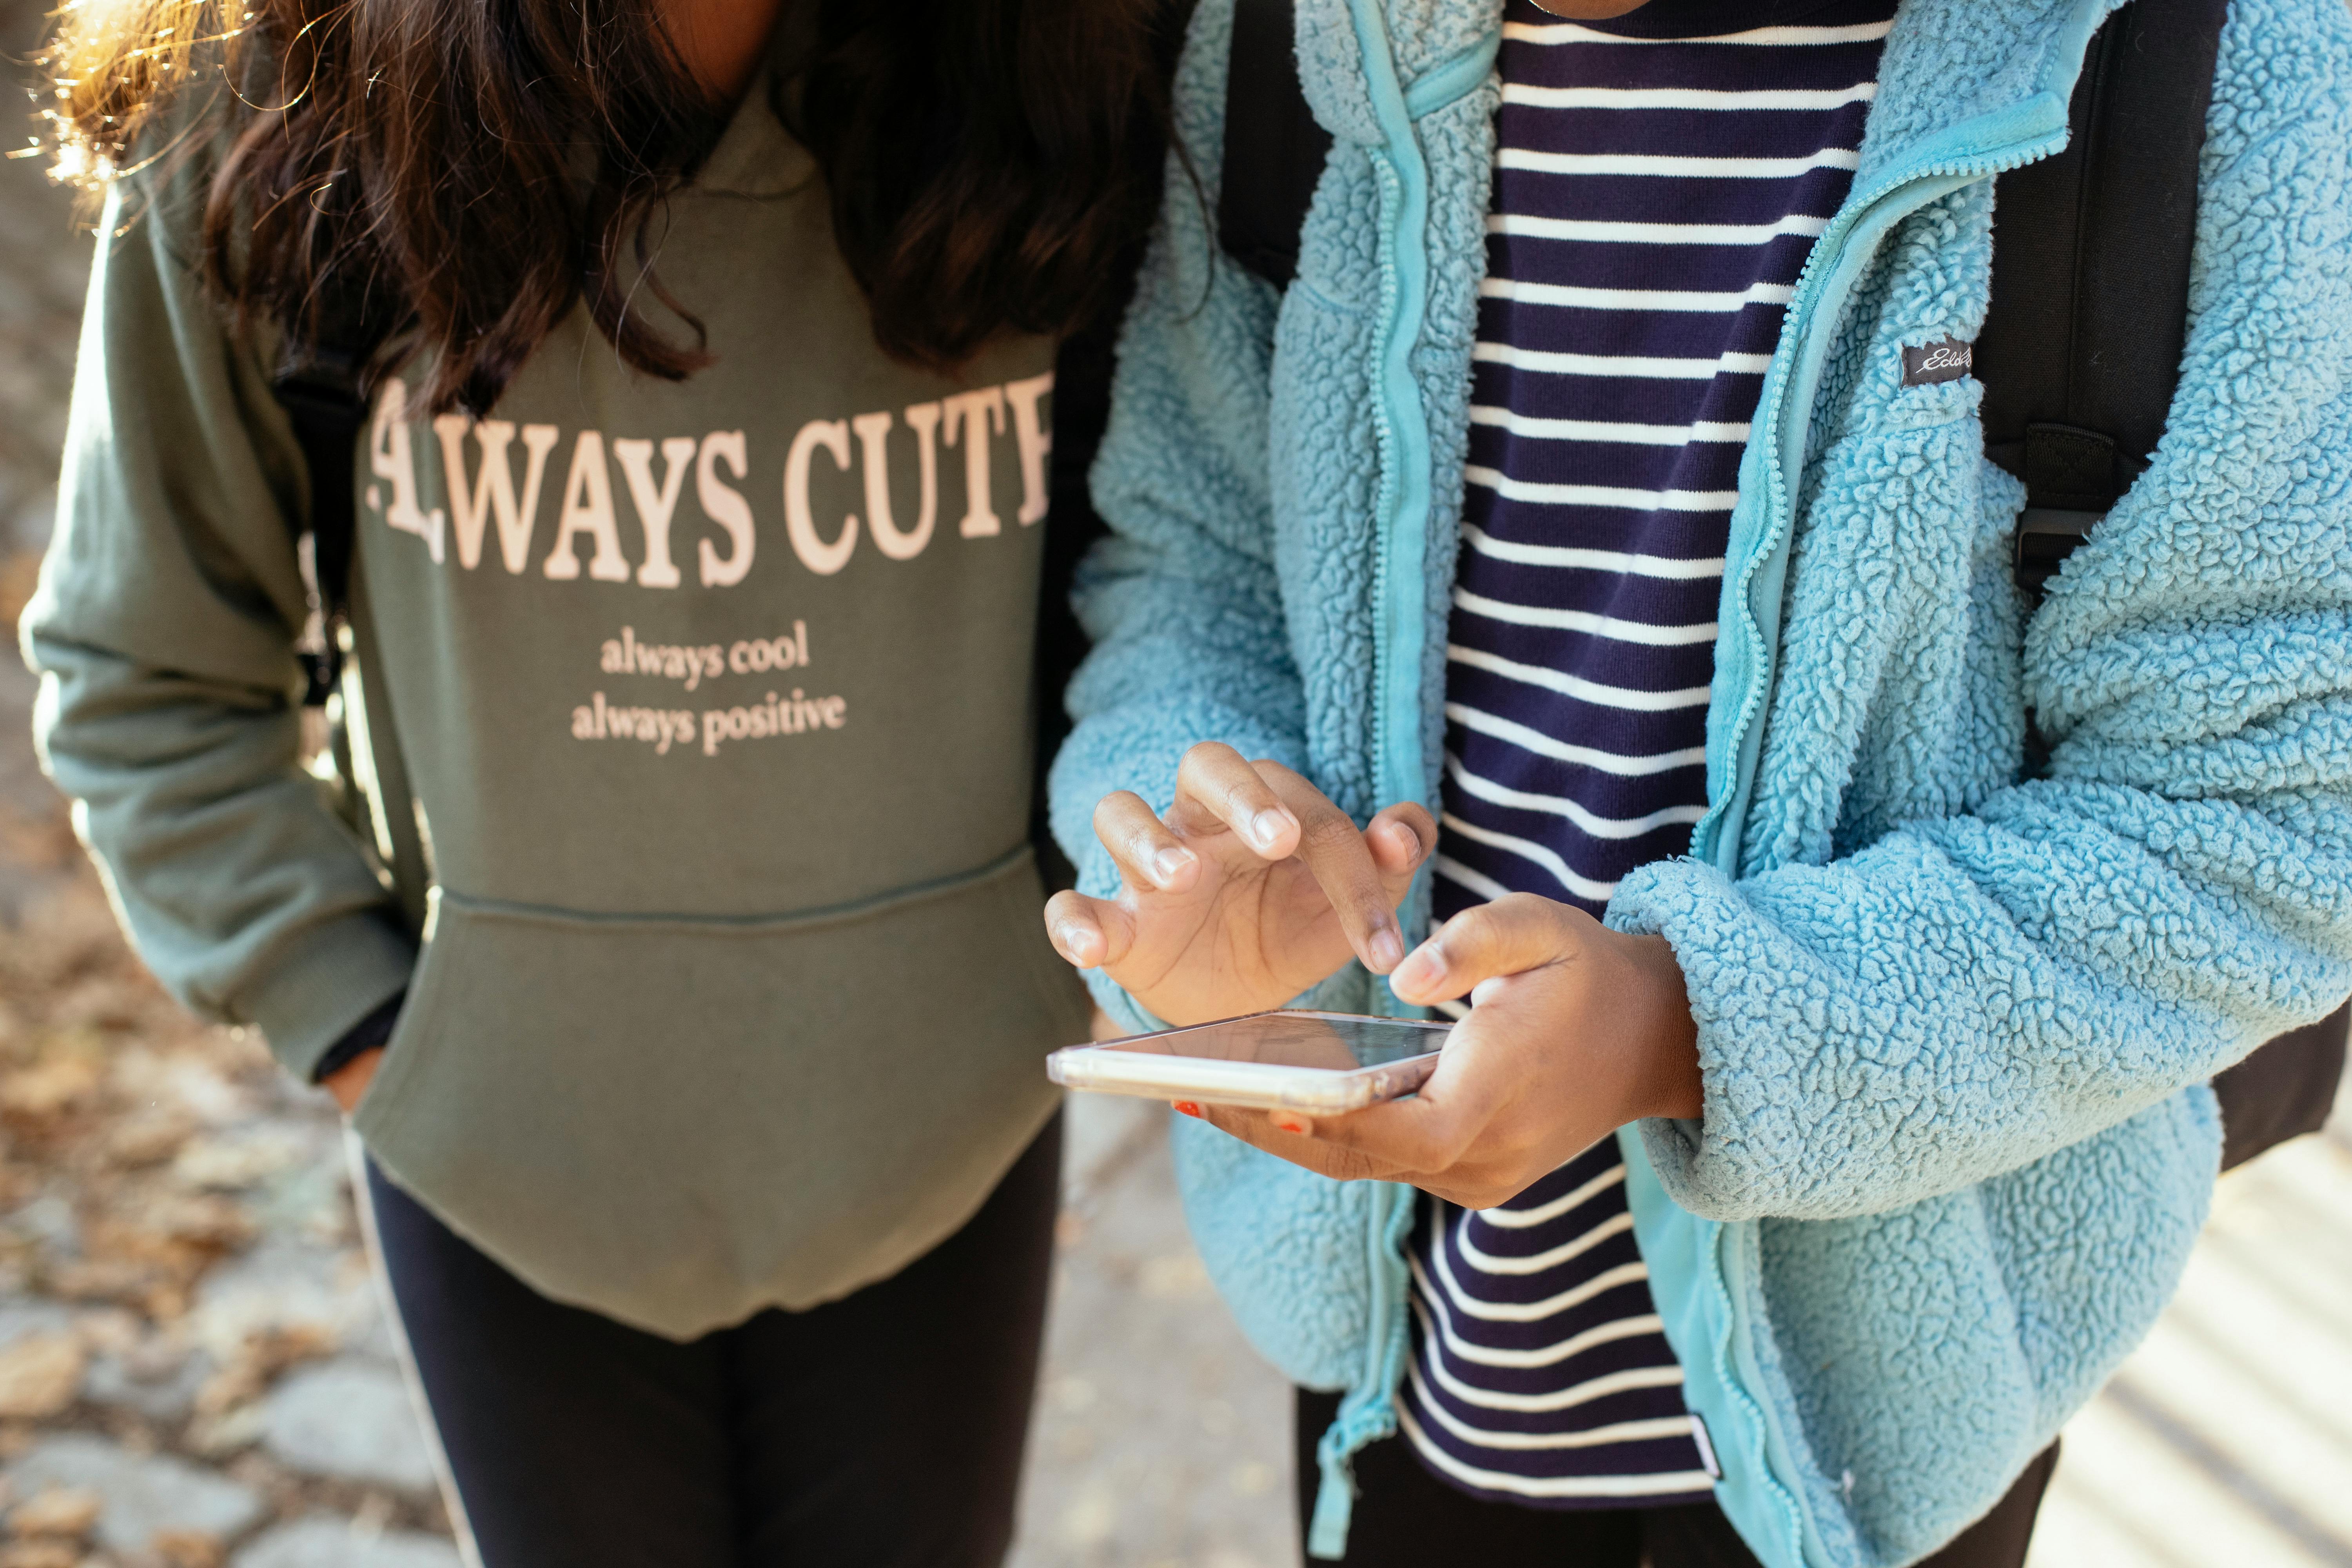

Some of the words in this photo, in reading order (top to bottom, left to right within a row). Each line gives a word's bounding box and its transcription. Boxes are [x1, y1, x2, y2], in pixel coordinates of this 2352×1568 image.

[367, 377, 757, 588] AWAYS
[600, 625, 724, 691] always
[728, 619, 809, 674] cool
[572, 691, 696, 755] always
[703, 687, 847, 757] positive
